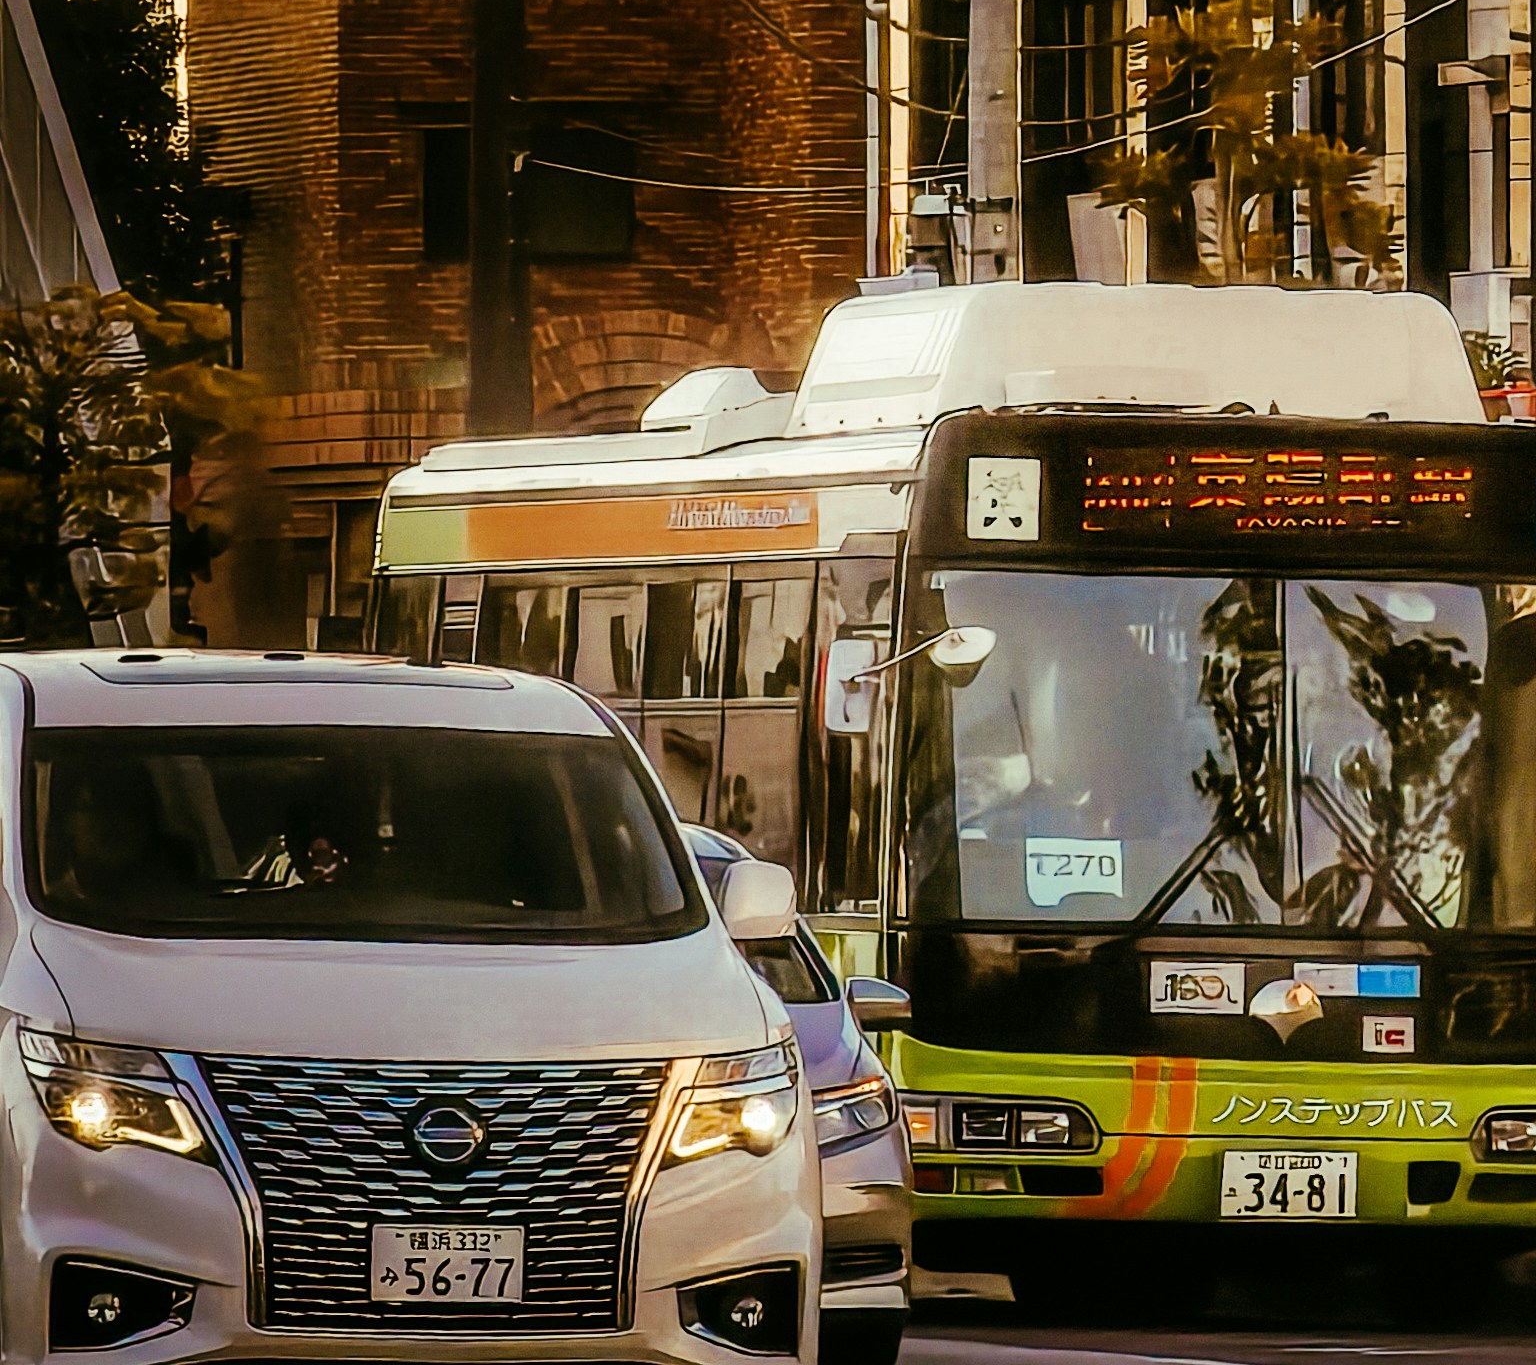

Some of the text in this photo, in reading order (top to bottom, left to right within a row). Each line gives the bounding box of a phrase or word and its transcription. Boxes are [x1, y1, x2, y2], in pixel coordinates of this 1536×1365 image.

[1029, 852, 1116, 877] T270
[1211, 1094, 1459, 1128] ノンステップバス
[1243, 1172, 1346, 1214] 34-81
[404, 1257, 516, 1297] 56-77
